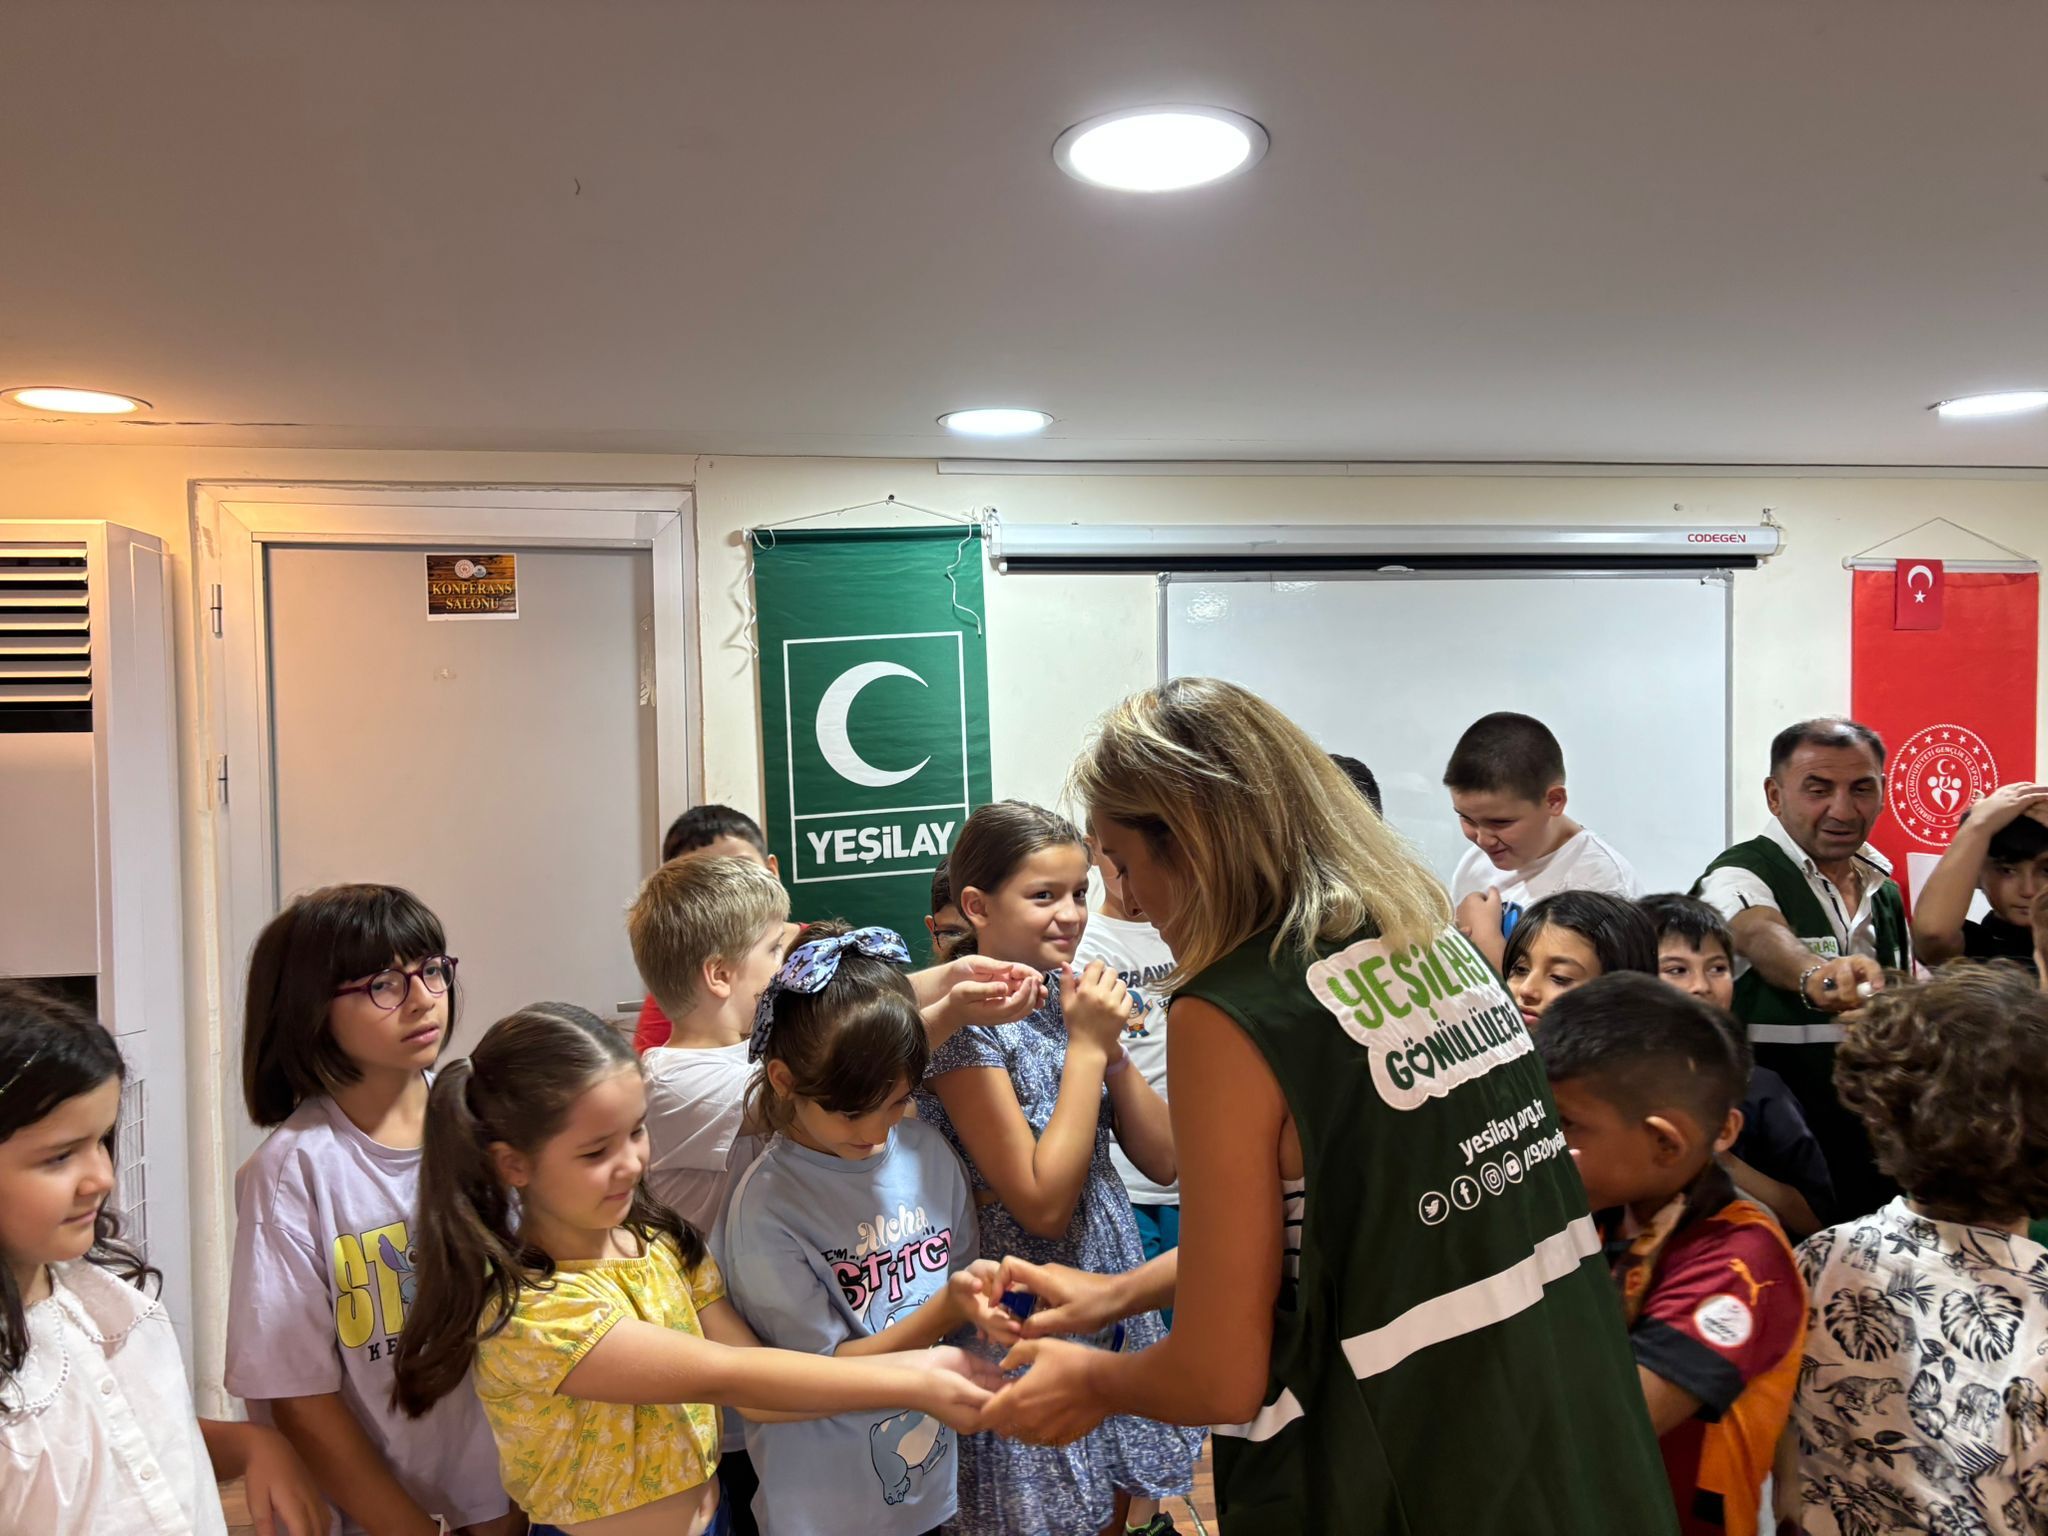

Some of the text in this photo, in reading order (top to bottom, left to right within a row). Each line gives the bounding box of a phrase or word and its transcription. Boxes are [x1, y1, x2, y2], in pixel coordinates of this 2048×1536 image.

[1687, 533, 1746, 543] CODEGEN
[432, 583, 512, 595] KONFERANS
[446, 597, 499, 609] SALONU
[1908, 748, 1935, 798] CUMHURİYETİ
[1935, 746, 1966, 758] GENÇLİK
[1964, 755, 1973, 766] VE
[1969, 765, 1979, 786] SPOR
[806, 821, 956, 865] YEŞİLAY
[1458, 1099, 1547, 1166] yesilay.org.tr
[856, 1203, 929, 1256] Aloha
